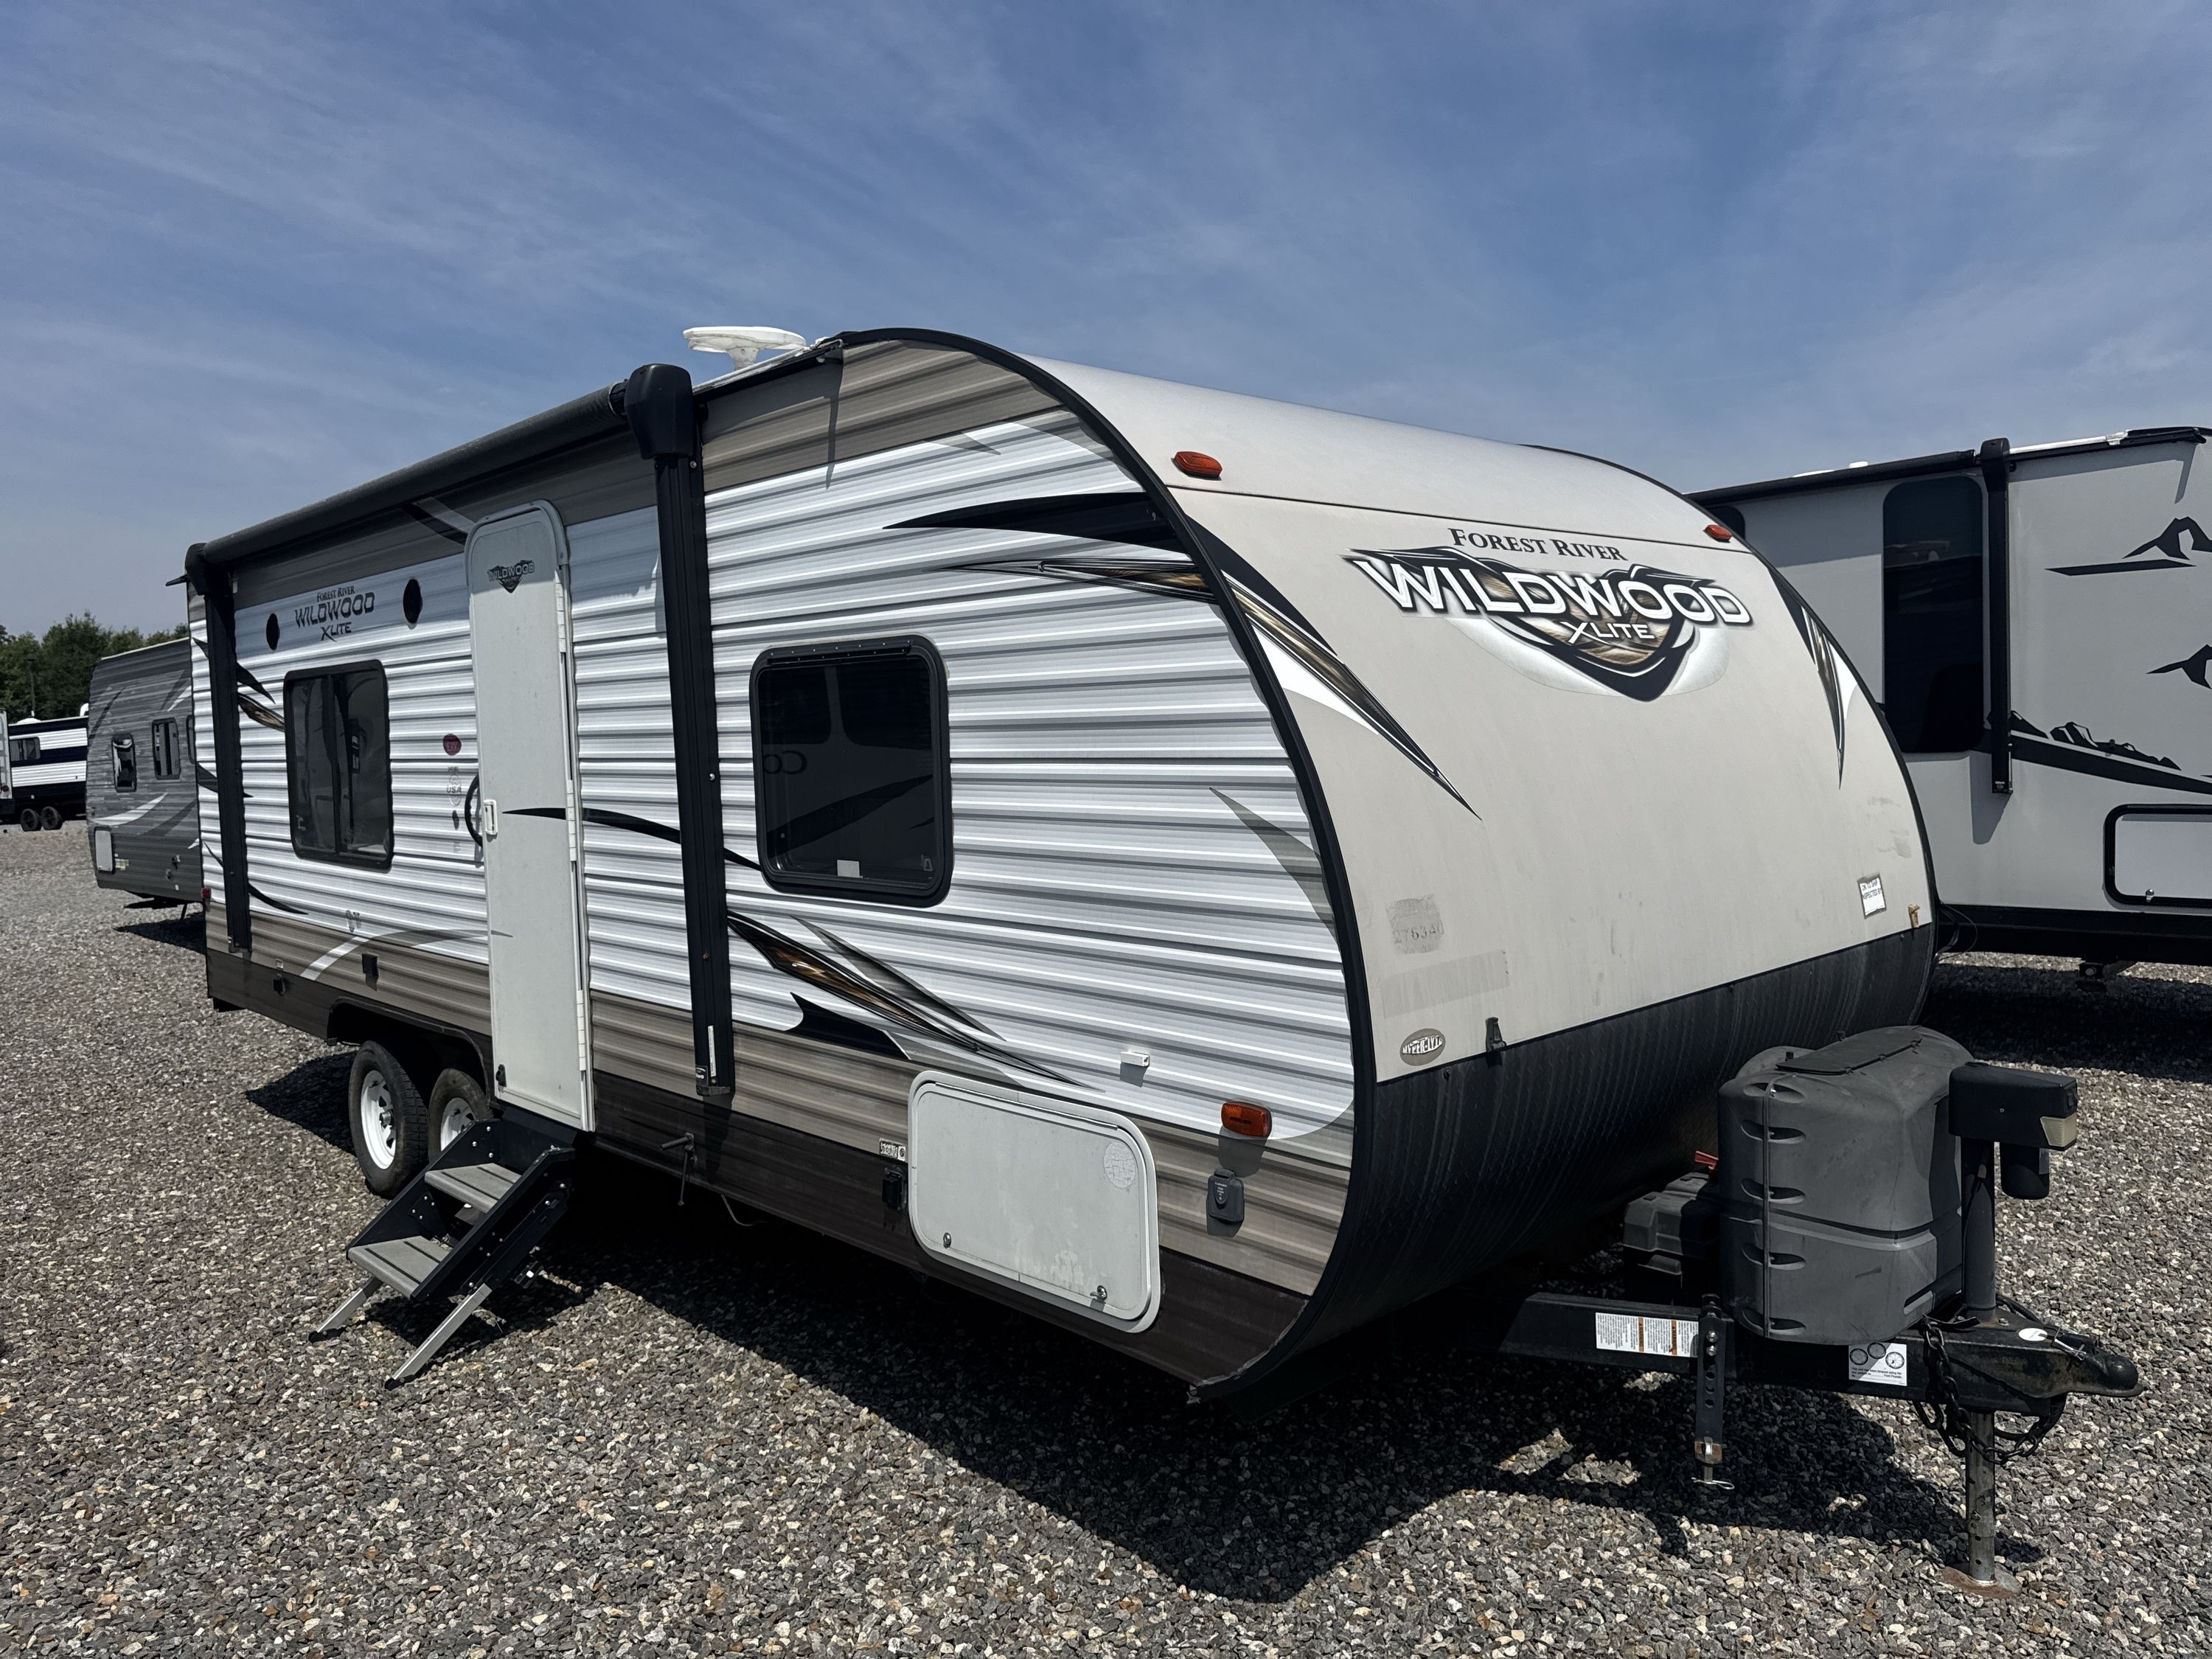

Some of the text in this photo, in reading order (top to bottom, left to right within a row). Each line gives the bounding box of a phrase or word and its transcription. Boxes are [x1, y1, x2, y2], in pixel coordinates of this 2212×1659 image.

[1447, 527, 1629, 561] FOREST RIVER
[487, 562, 535, 582] WILDWOOD
[316, 585, 355, 602] FOREST RIVER
[1351, 560, 1753, 625] WILDWOOD
[295, 592, 375, 628] WILDWOOD
